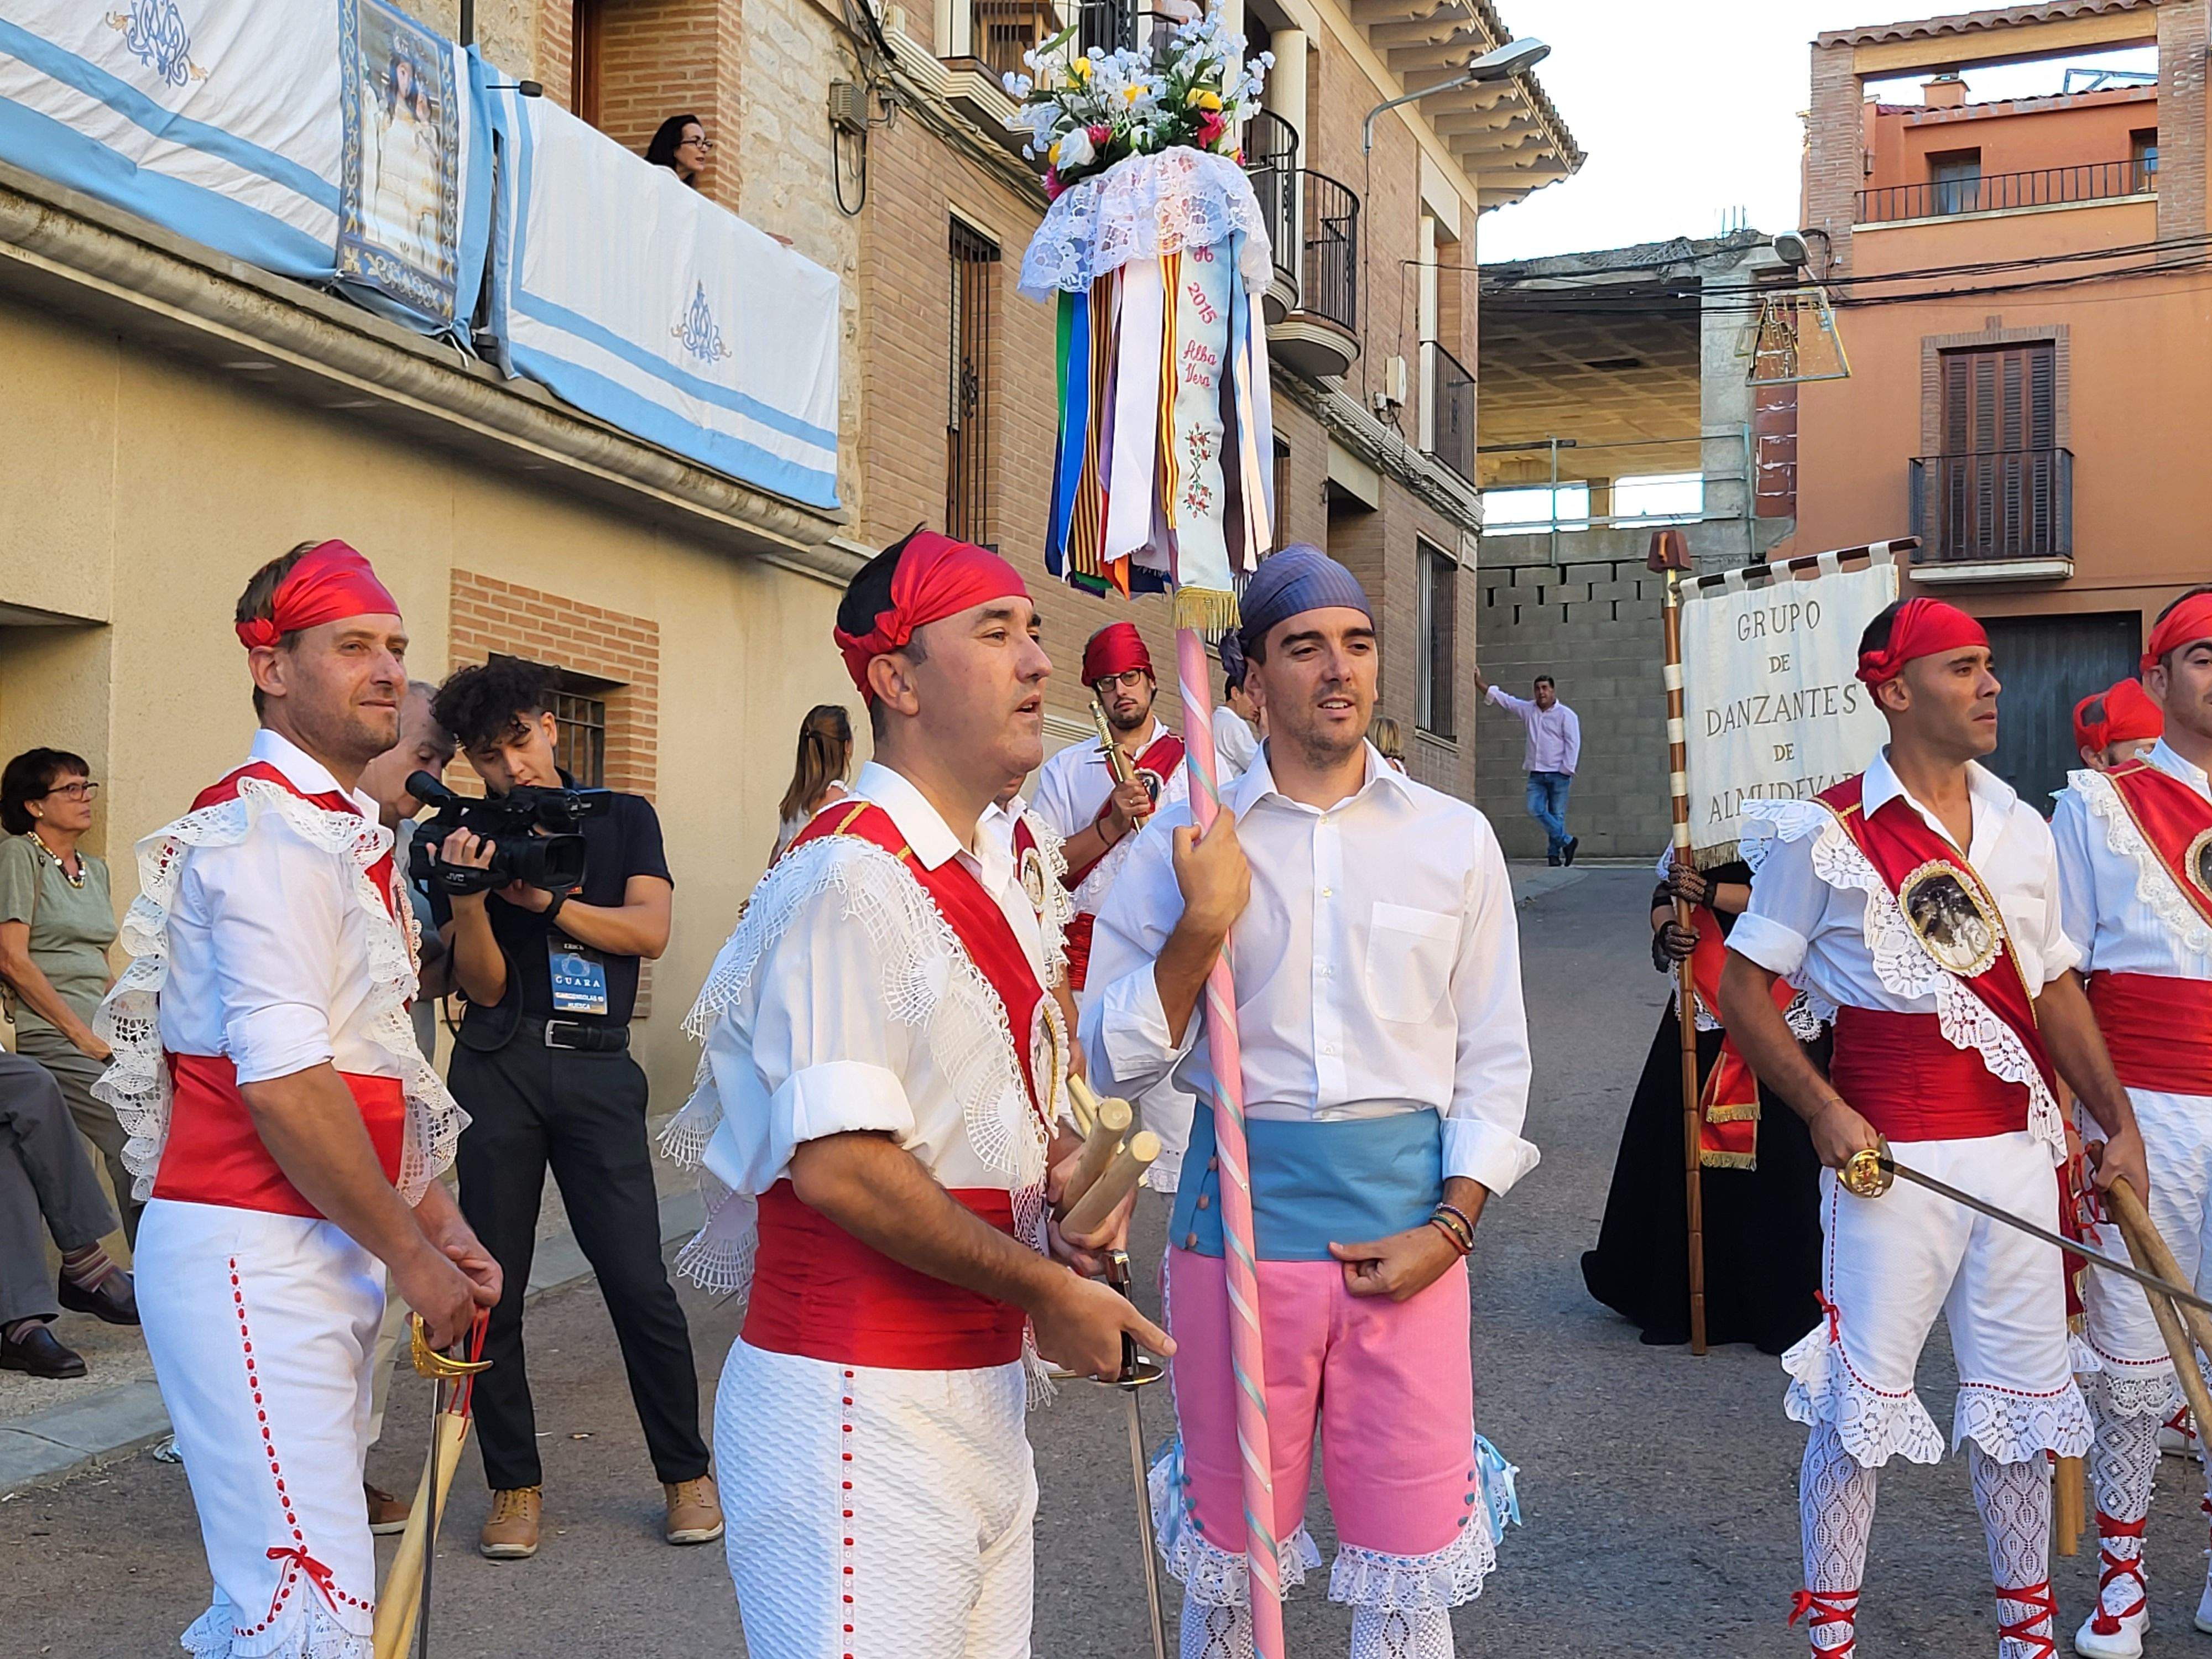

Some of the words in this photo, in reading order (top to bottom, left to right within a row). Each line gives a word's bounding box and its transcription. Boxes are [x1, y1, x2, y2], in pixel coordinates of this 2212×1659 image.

[1187, 282, 1218, 324] 2015
[1183, 339, 1217, 366] Alba
[1185, 363, 1211, 387] Vera
[1738, 600, 1821, 641] GRUPO
[1768, 654, 1791, 674] DE
[1705, 684, 1858, 737] DANZANTES
[1773, 743, 1794, 762] DE
[1708, 773, 1855, 824] ALMUDEV
[446, 872, 465, 882] JVC
